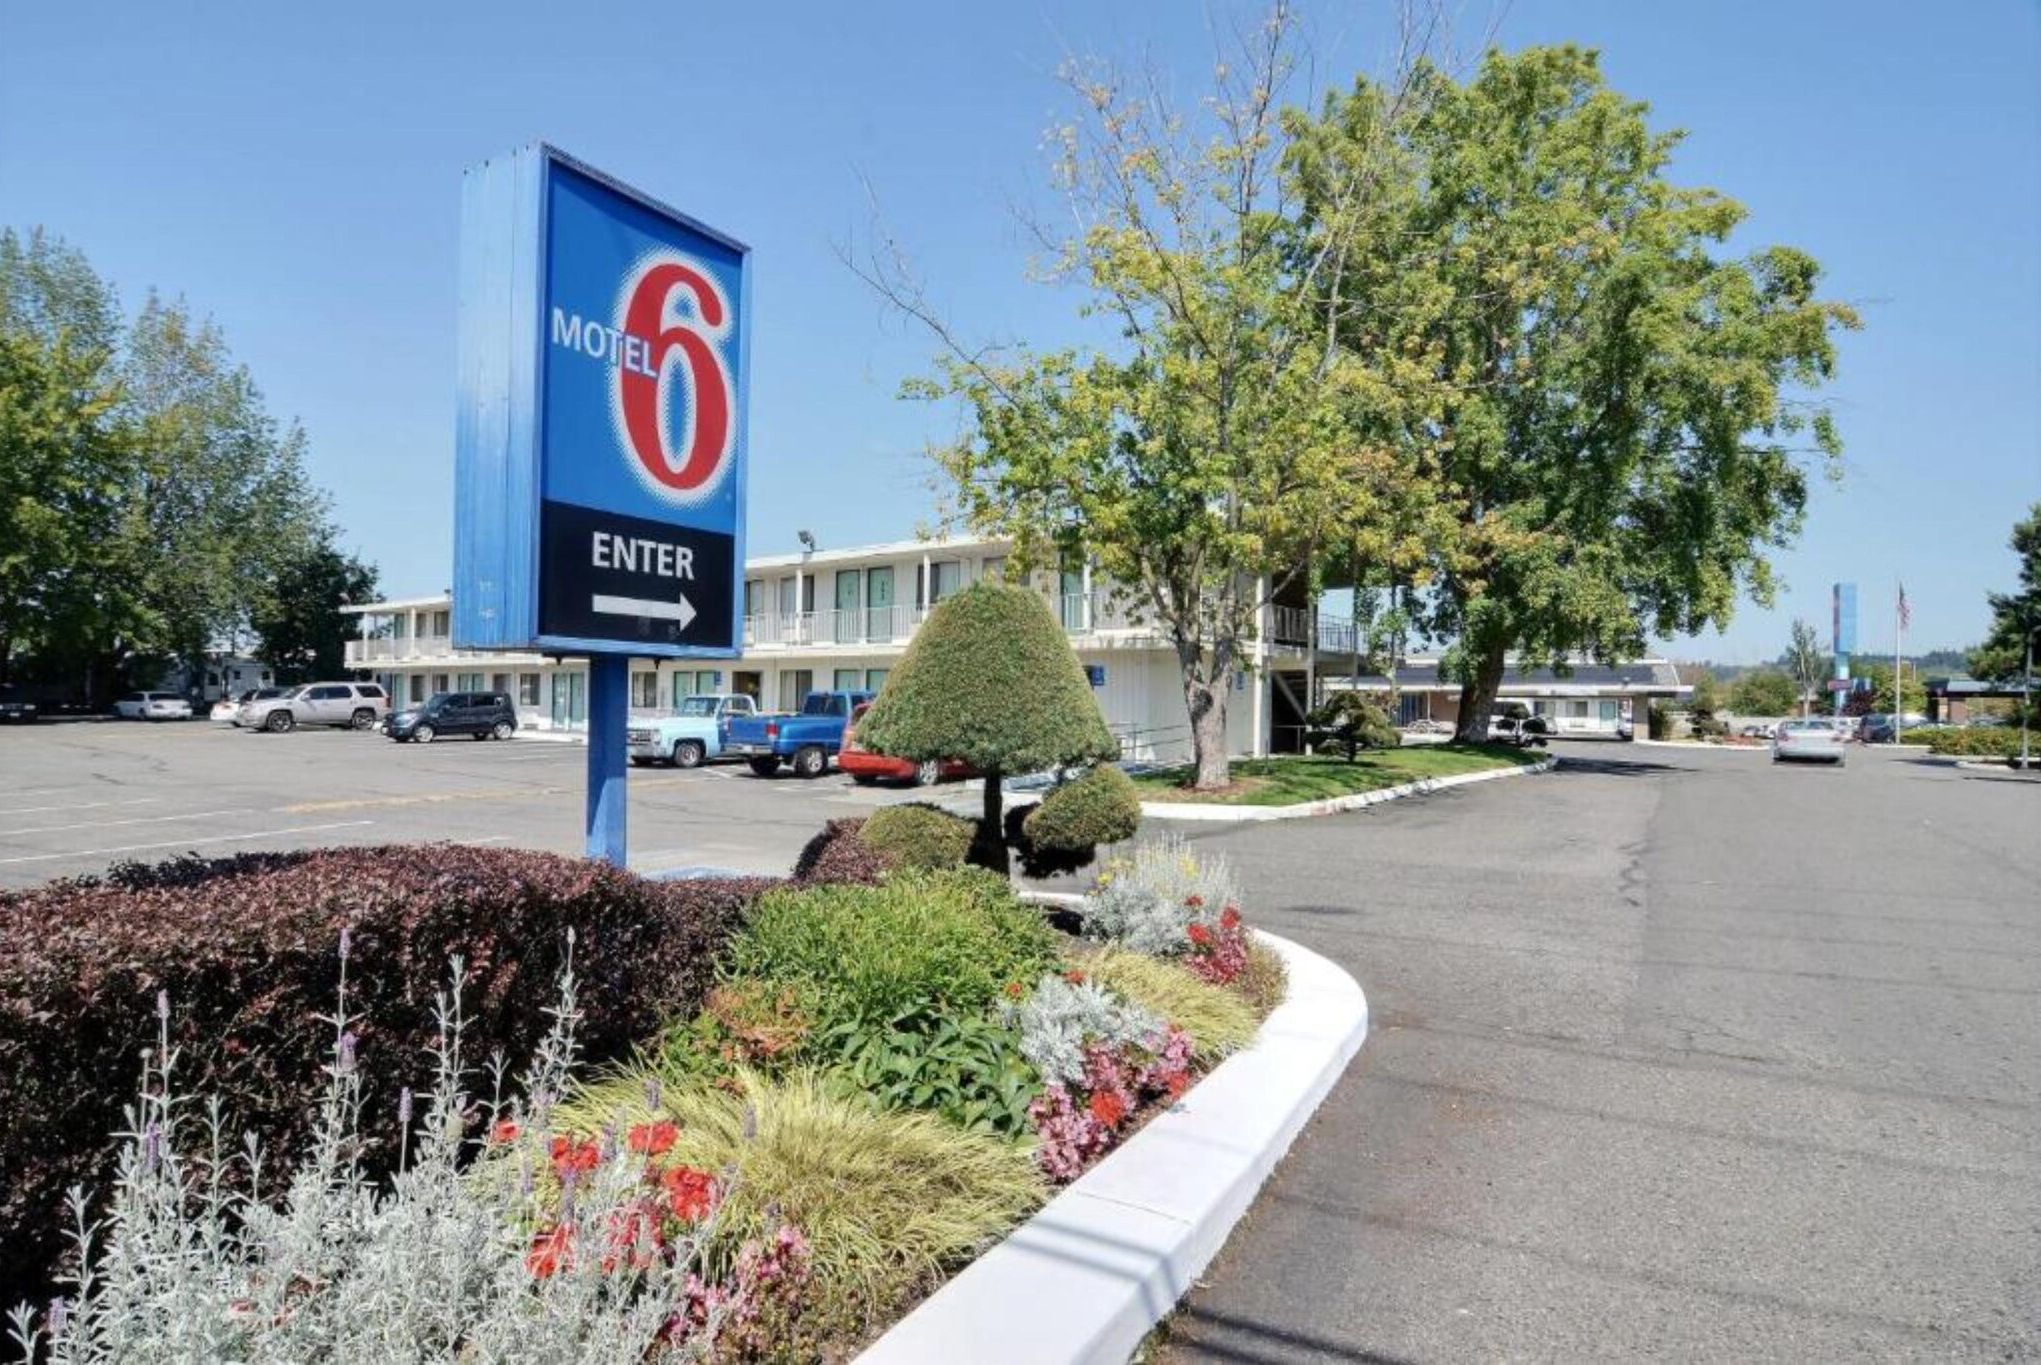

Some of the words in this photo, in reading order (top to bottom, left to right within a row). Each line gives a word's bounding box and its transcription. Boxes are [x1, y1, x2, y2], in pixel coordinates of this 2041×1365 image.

[551, 306, 658, 379] MOTEL
[620, 261, 729, 491] 6
[591, 530, 695, 581] ENTER
